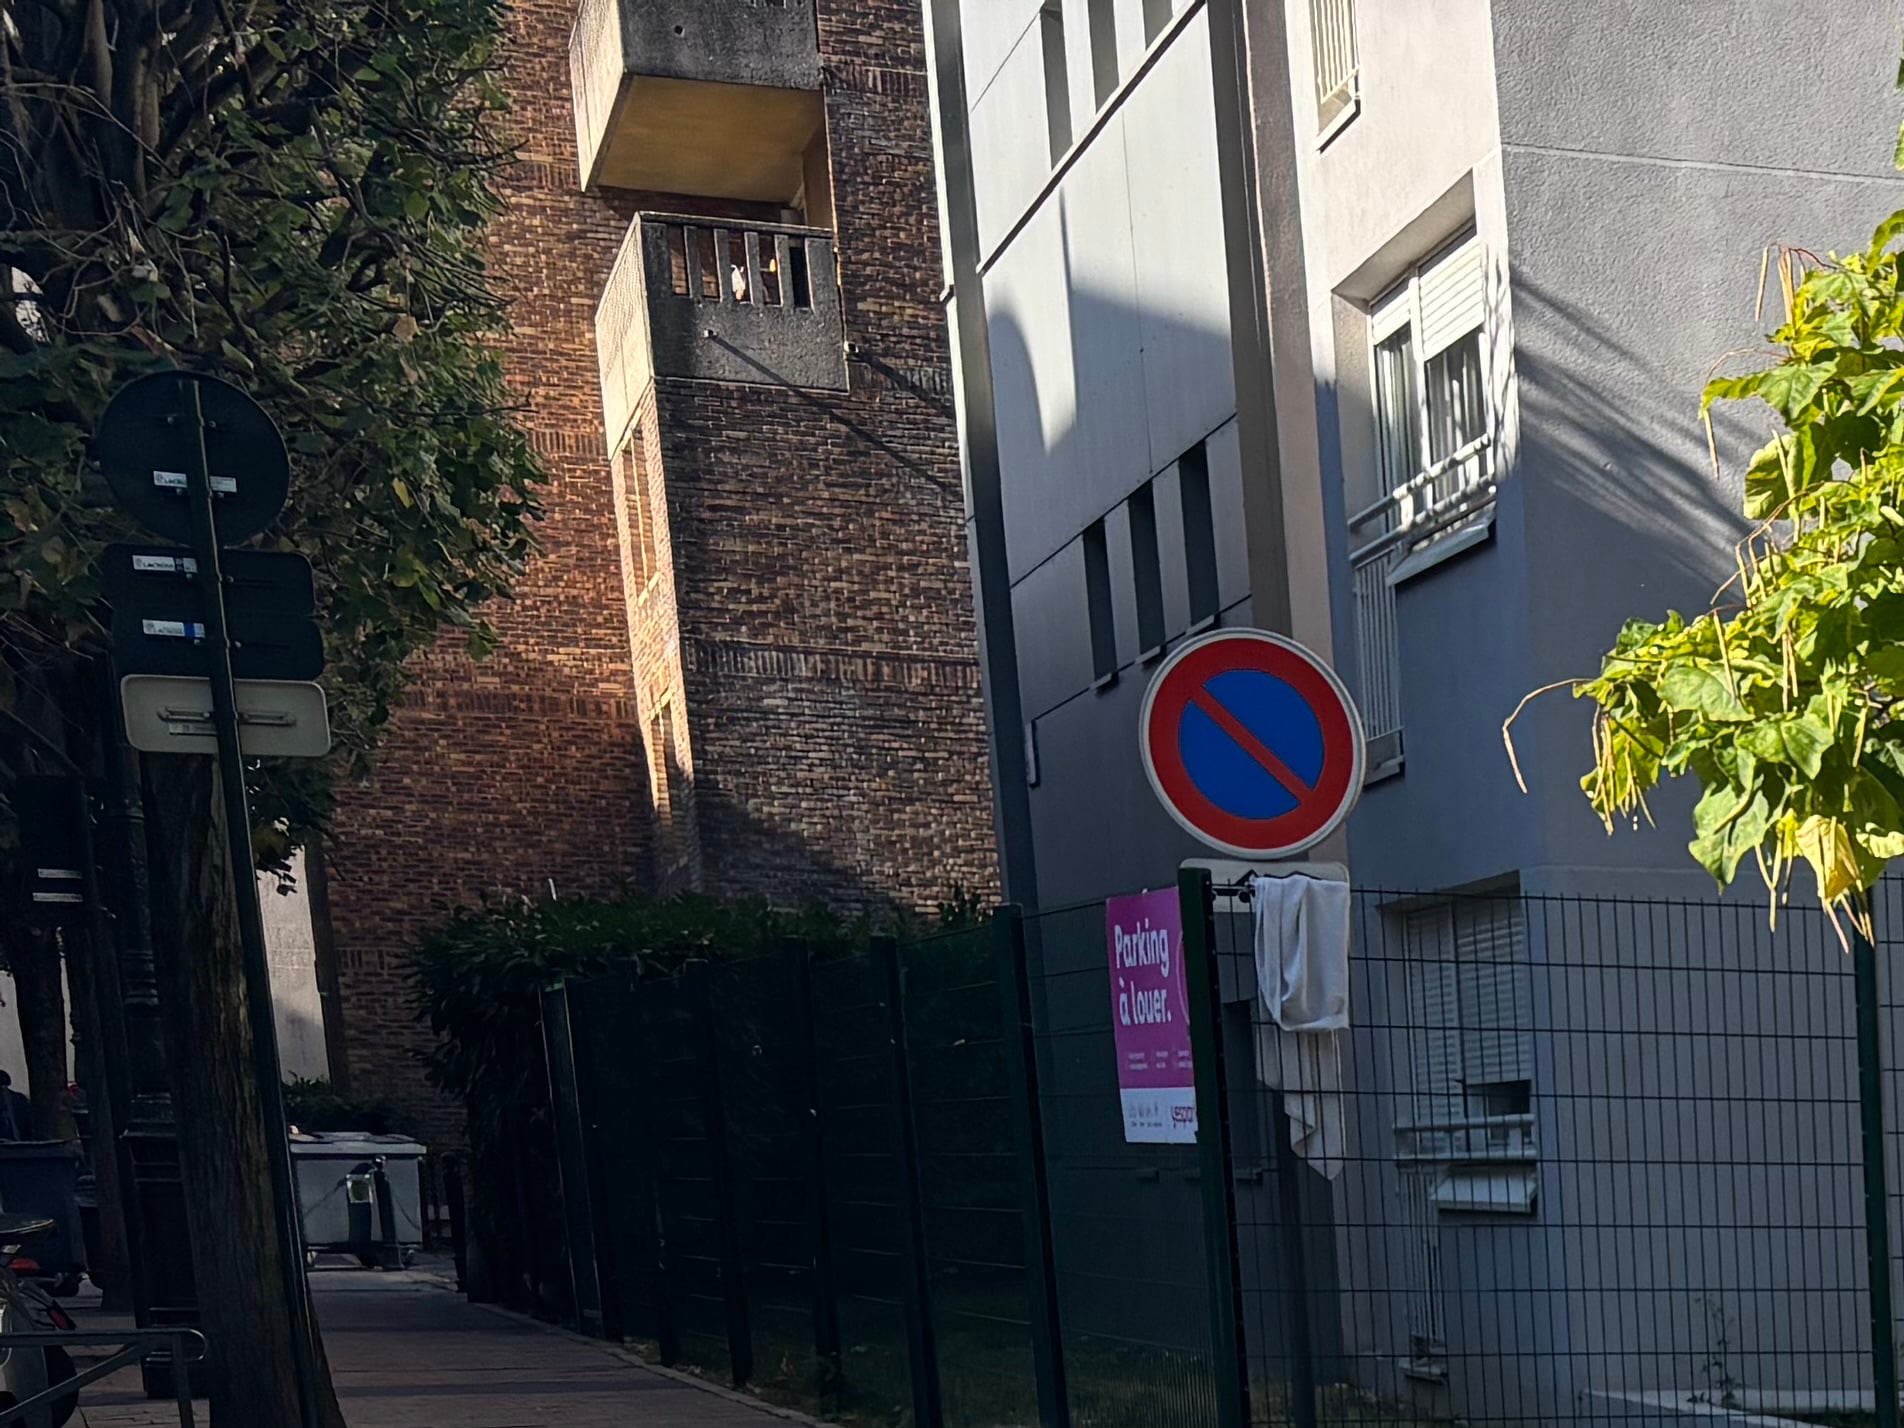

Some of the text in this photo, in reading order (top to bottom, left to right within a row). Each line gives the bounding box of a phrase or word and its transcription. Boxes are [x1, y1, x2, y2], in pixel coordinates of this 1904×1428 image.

[1114, 917, 1170, 978] Parking
[1119, 976, 1172, 1026] à louer.
